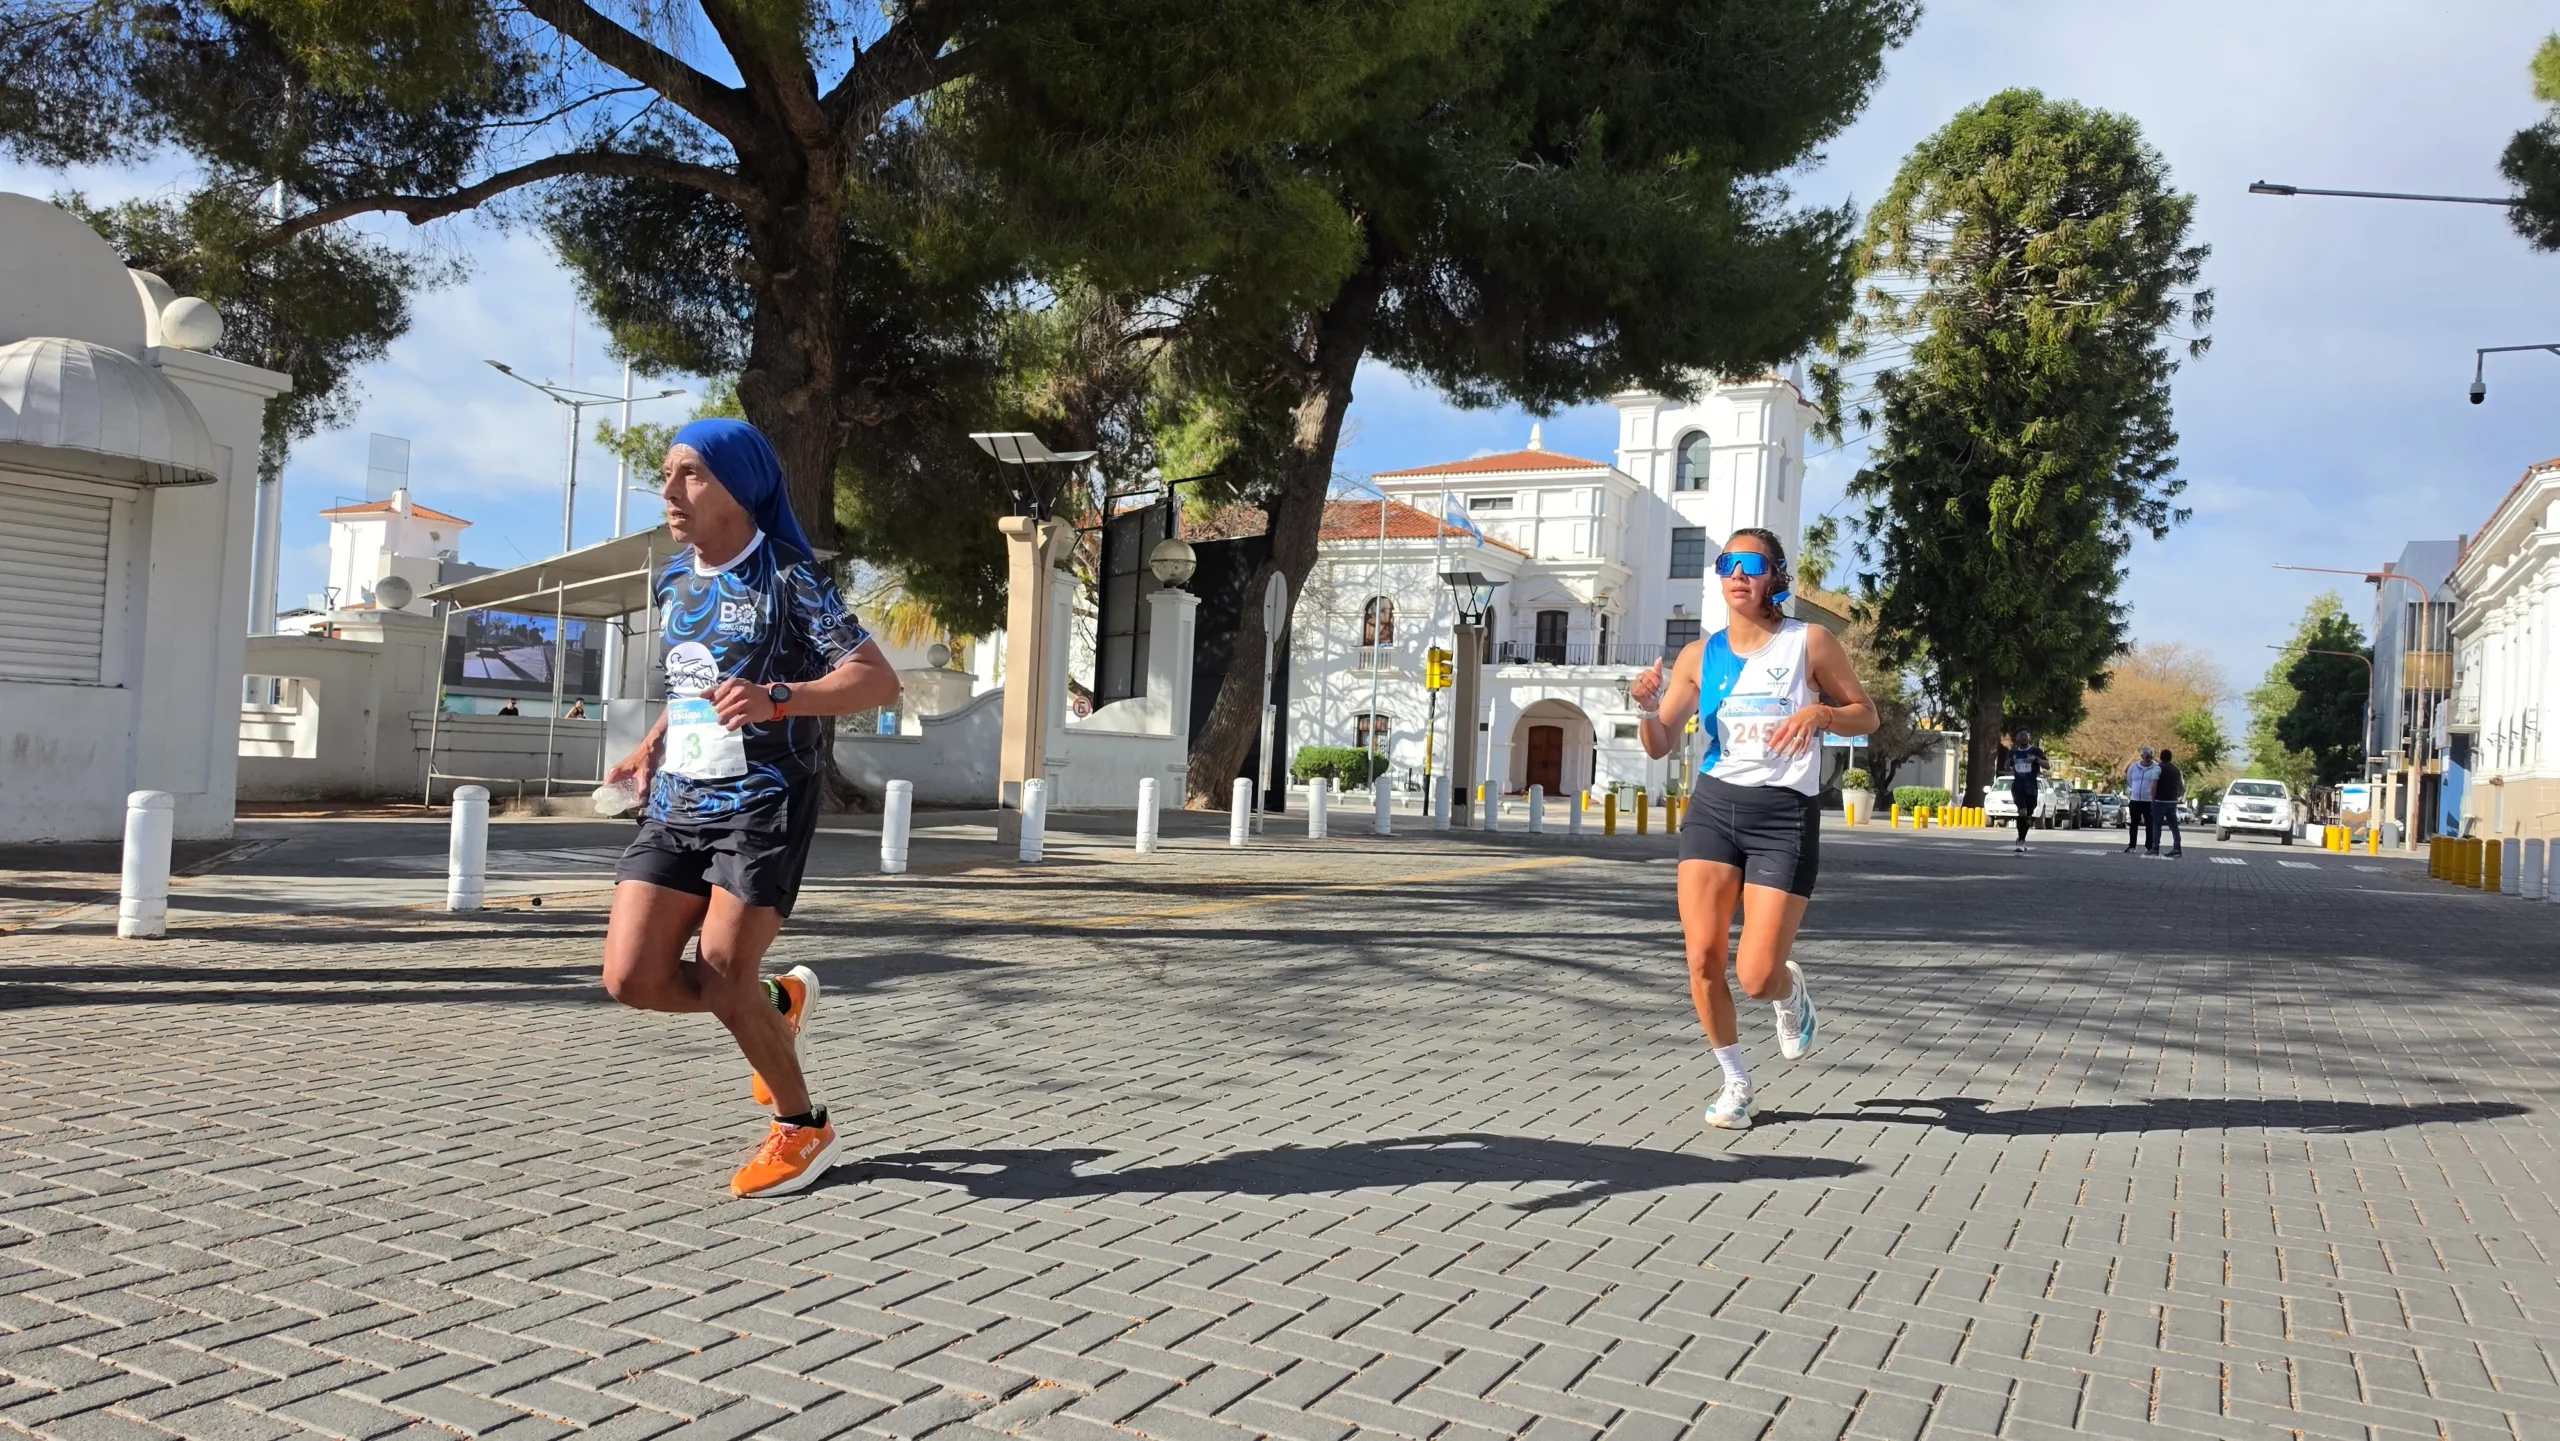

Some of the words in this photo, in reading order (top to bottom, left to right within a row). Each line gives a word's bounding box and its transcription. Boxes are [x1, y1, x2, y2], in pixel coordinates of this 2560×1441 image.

[718, 622, 755, 635] BONARDA
[686, 732, 702, 759] 3
[799, 1137, 820, 1160] FILA
